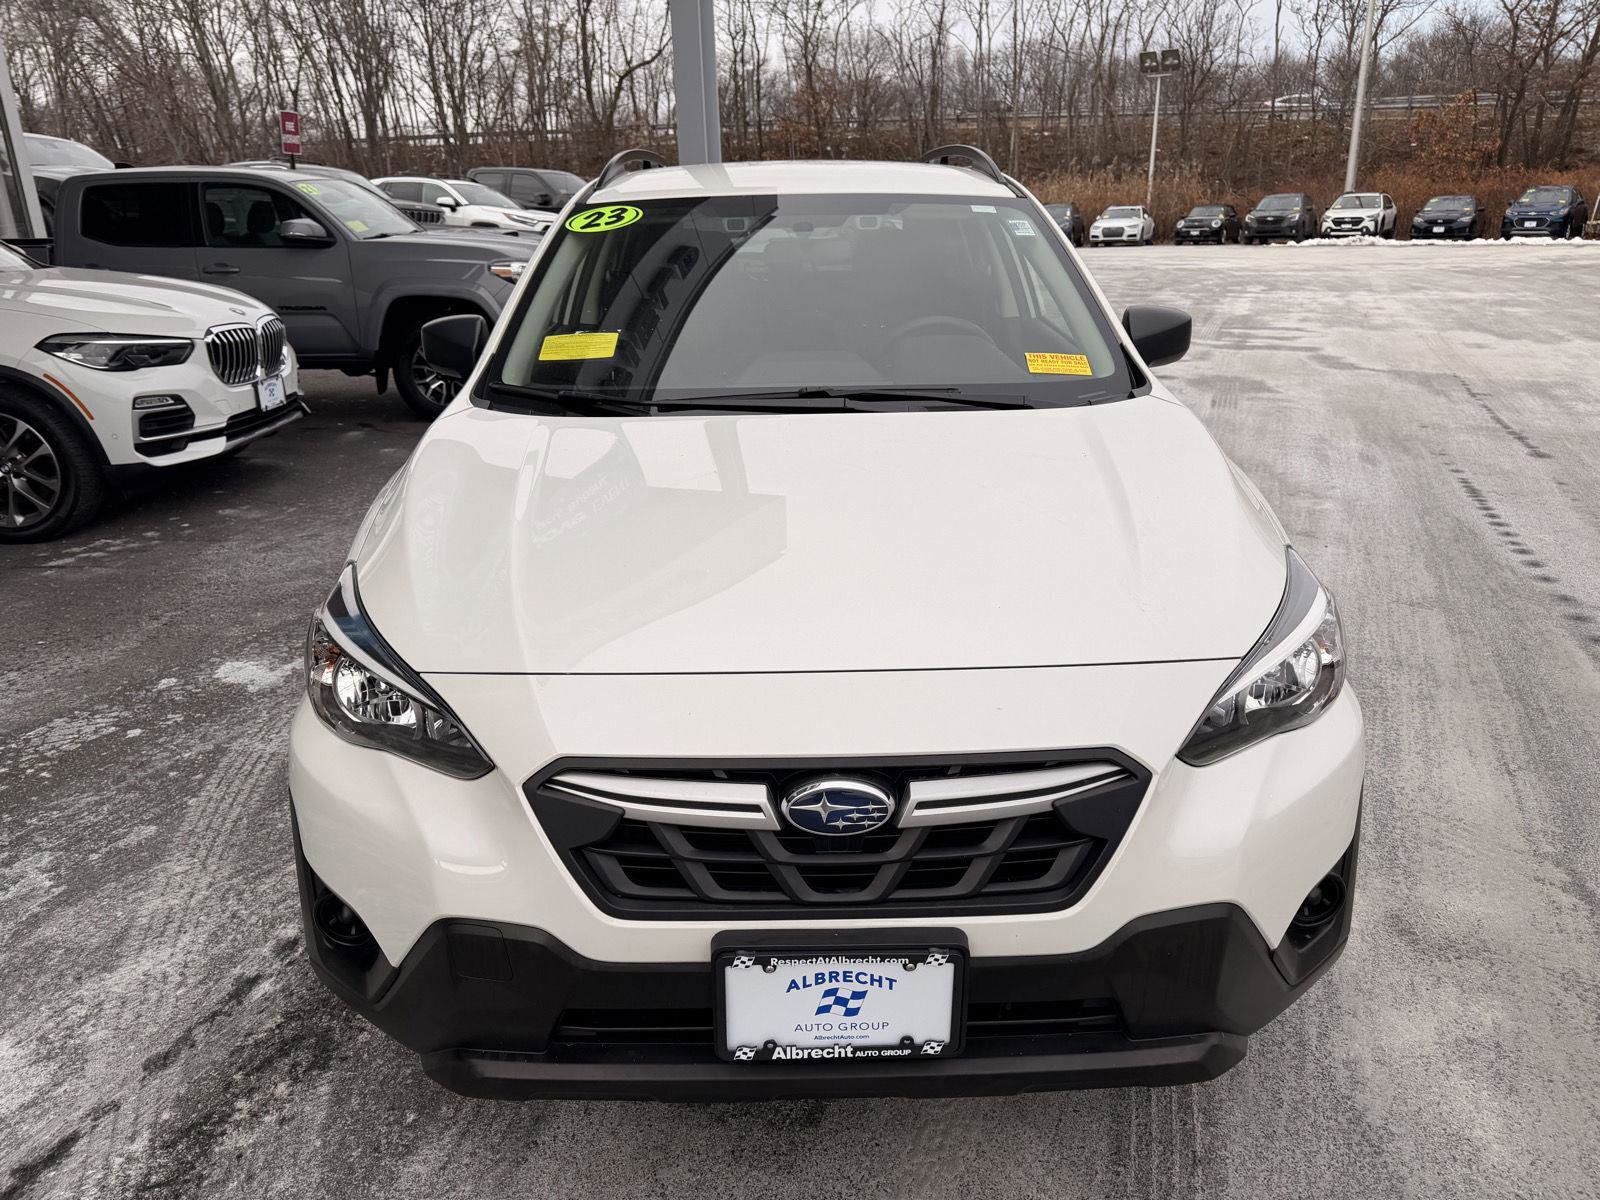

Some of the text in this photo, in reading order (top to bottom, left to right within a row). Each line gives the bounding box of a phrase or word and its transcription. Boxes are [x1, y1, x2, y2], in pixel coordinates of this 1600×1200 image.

[579, 207, 629, 230] 23
[770, 956, 909, 967] RespectAtAlbrecht.com
[786, 970, 897, 993] ALBRECHT
[794, 1021, 890, 1032] AUTO GROUP
[771, 1043, 853, 1060] Albrecht
